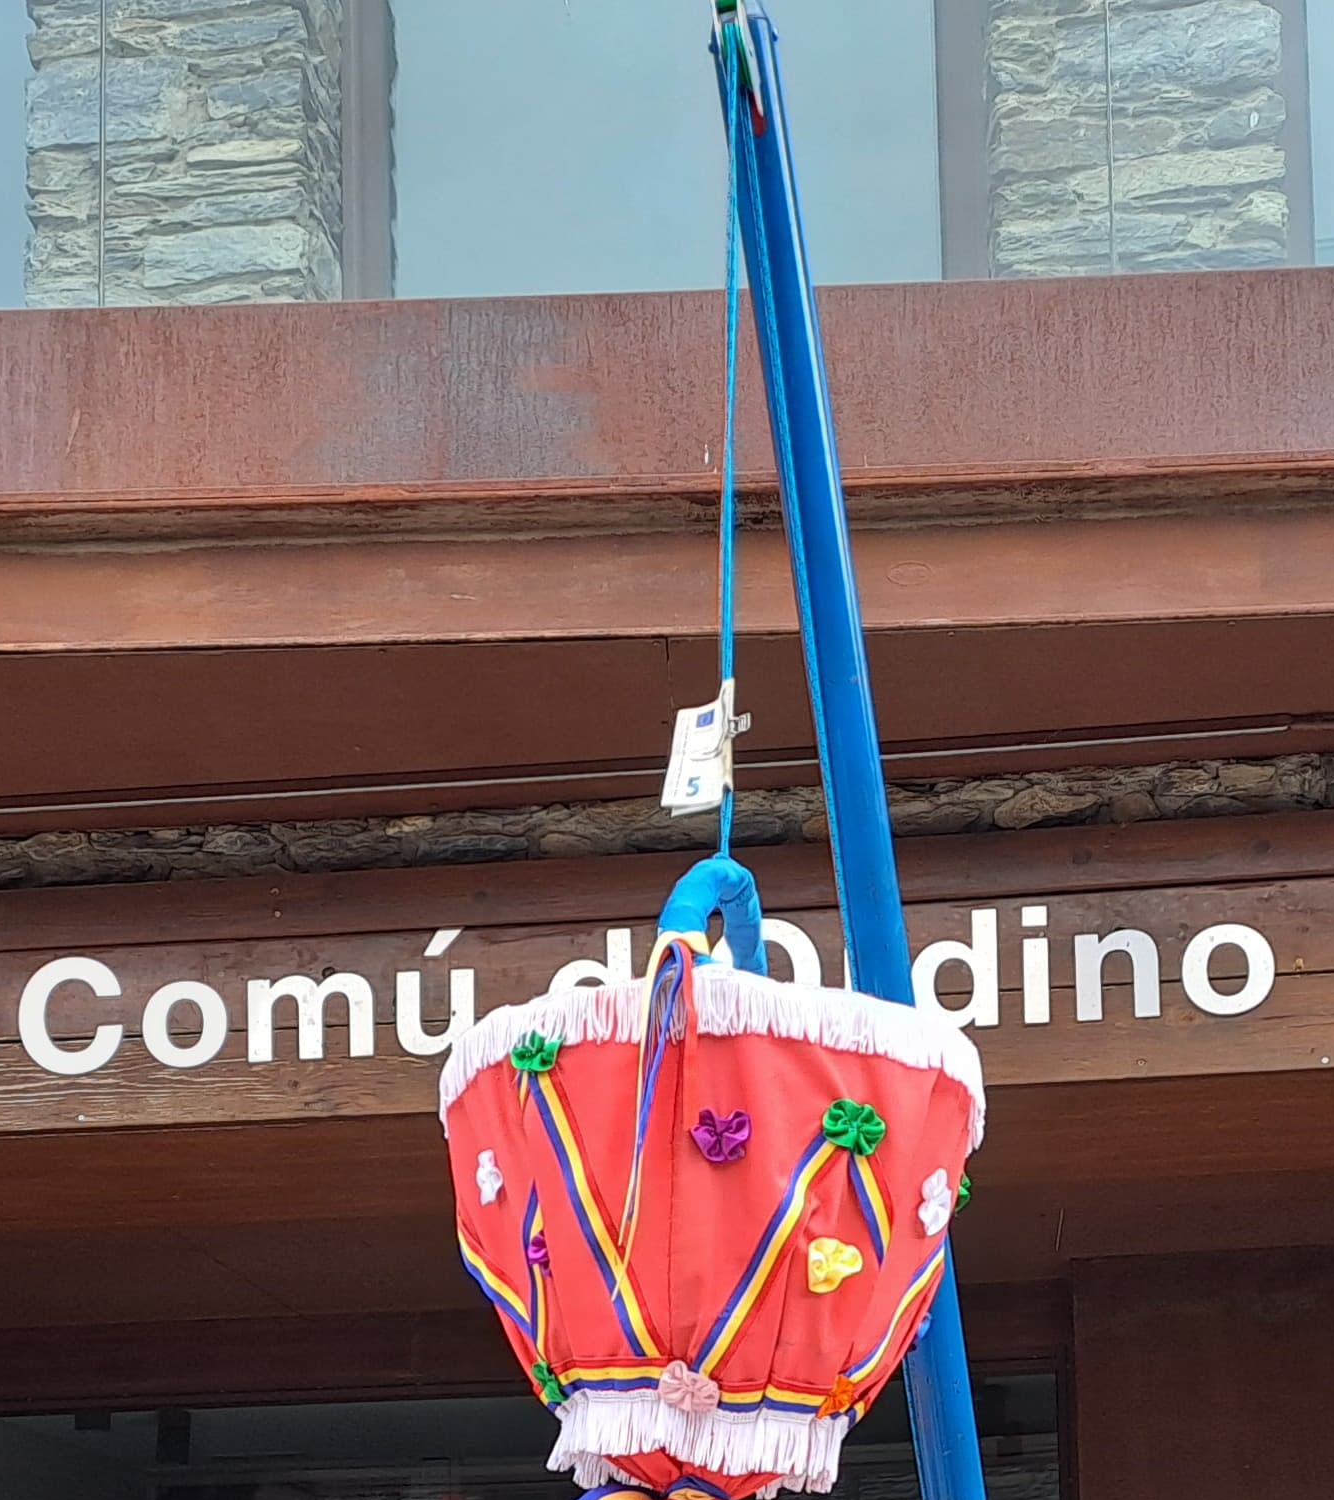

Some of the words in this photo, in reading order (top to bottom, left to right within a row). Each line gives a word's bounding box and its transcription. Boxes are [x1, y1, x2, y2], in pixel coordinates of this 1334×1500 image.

[685, 775, 701, 797] 5
[18, 927, 476, 1075] Comú
[546, 904, 1276, 1029] ddino
